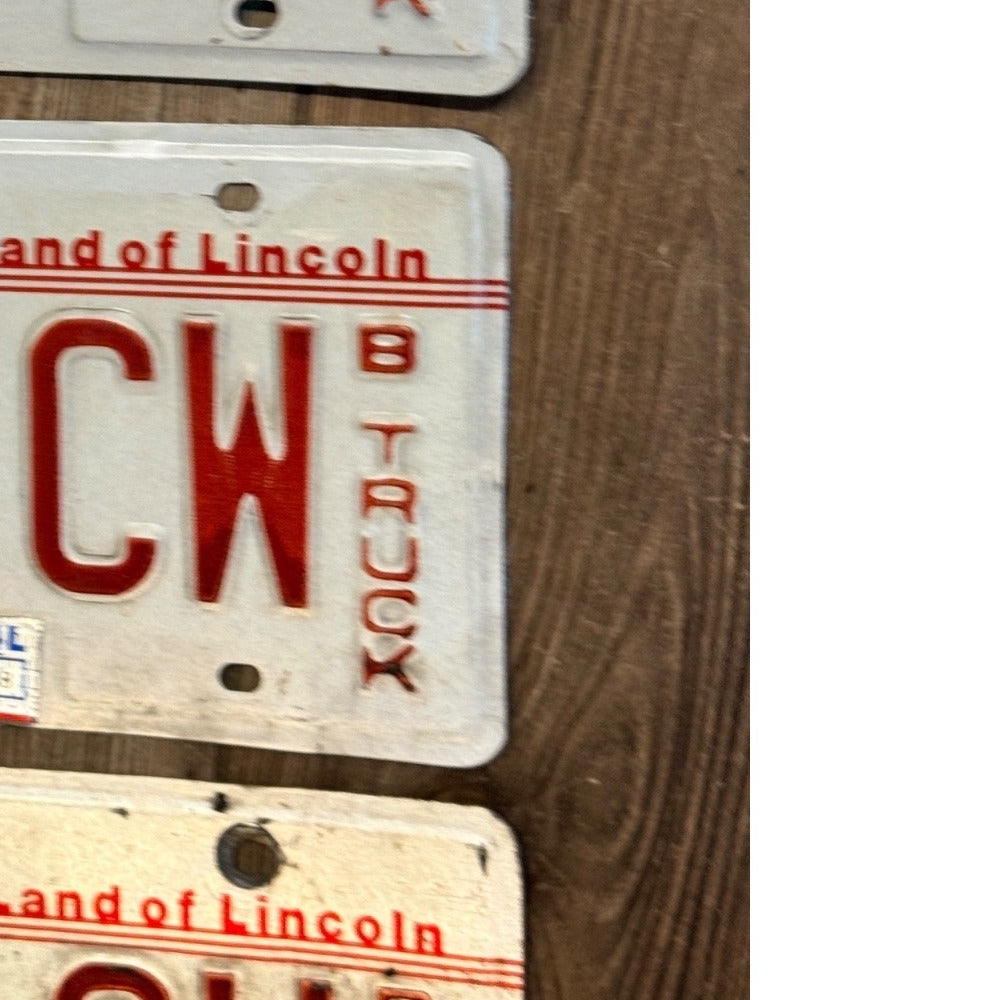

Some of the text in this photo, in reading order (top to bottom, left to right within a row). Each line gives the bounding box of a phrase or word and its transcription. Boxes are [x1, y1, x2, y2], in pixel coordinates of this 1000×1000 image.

[118, 231, 177, 271] of
[200, 233, 430, 281] Lincoln
[359, 323, 417, 373] B
[27, 318, 315, 608] CW
[360, 422, 419, 693] TRUCK
[140, 890, 196, 931] of
[220, 894, 446, 956] Lincoln
